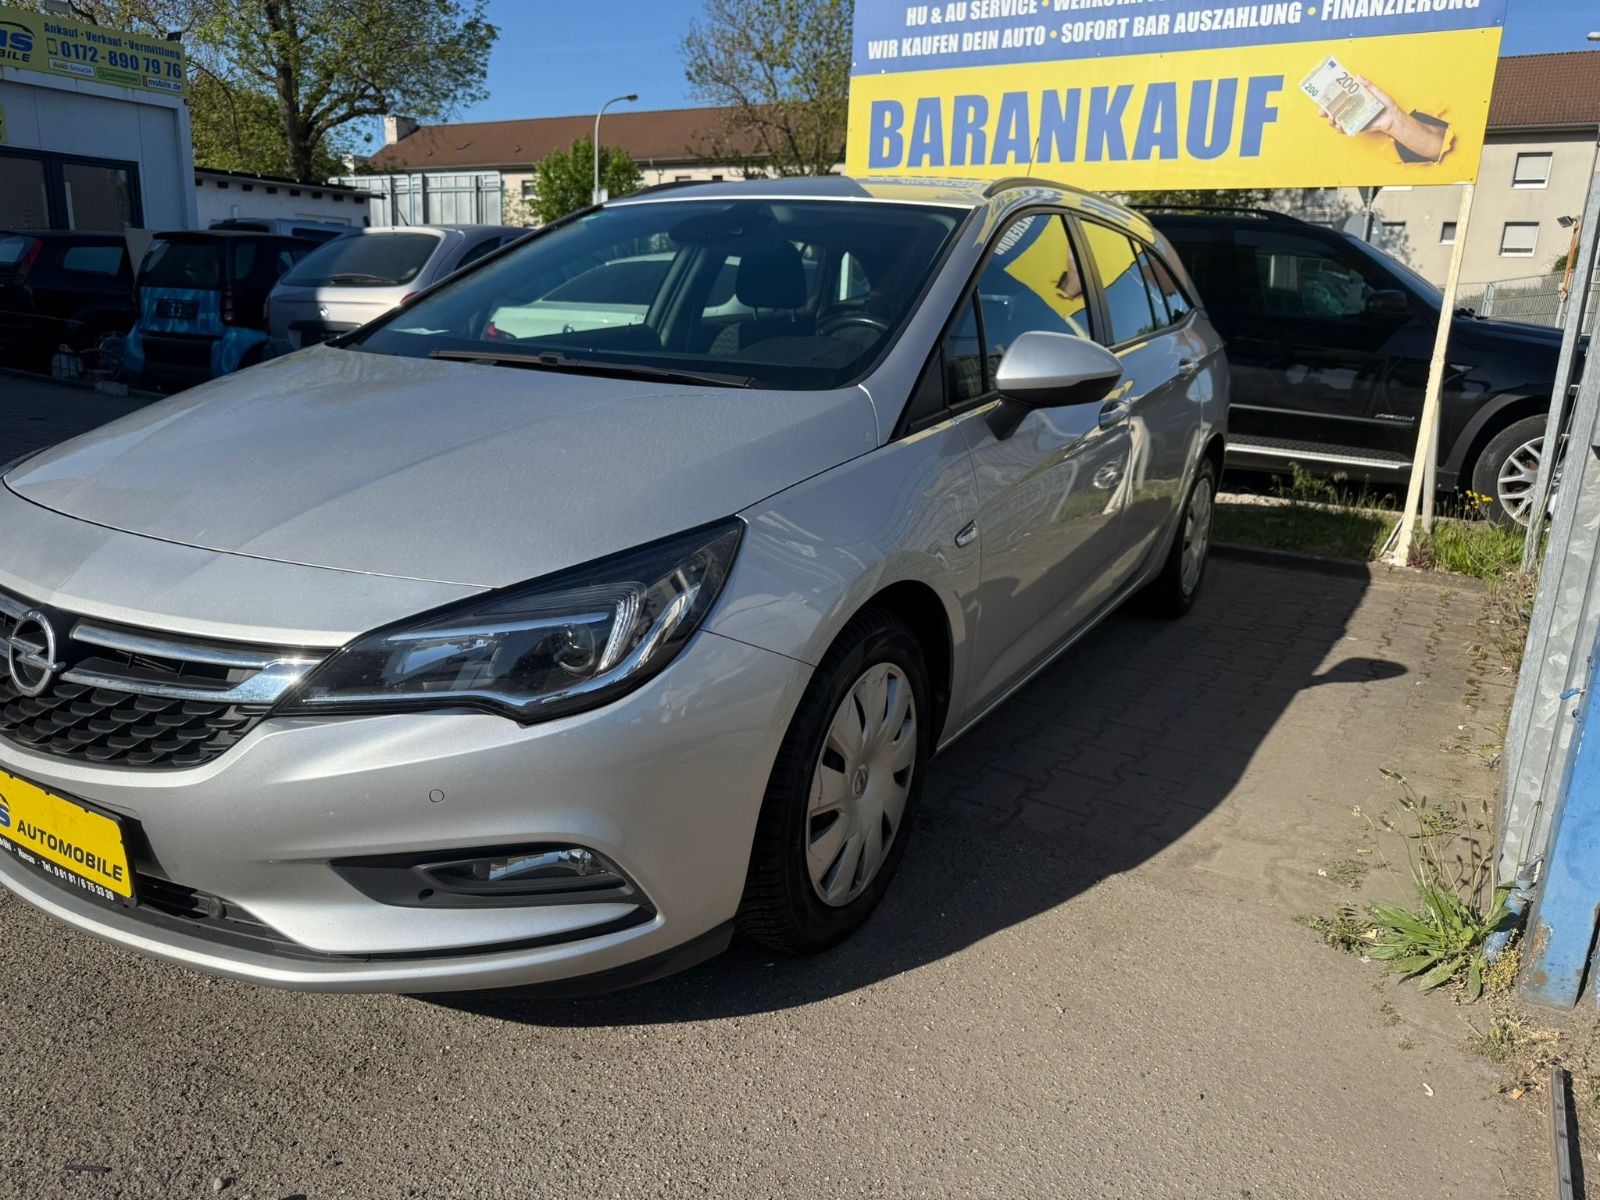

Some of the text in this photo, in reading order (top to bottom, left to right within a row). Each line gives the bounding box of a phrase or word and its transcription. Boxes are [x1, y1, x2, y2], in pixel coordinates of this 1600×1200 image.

[905, 6, 928, 26] HU
[930, 7, 942, 24] &
[944, 2, 968, 23] AU
[970, 0, 1038, 20] SERVICE
[44, 22, 181, 60] Ankauf Verkauf Vermittlung
[868, 38, 899, 60] WIR
[901, 33, 960, 57] KAUFEN
[962, 29, 1000, 54] DEIN
[1001, 25, 1046, 49] AUTO
[1061, 18, 1130, 44] SOFORT
[1132, 14, 1171, 38] BAR
[1173, 1, 1302, 35] AUSZAHLUNG
[143, 57, 161, 75] 79
[165, 61, 182, 79] 76
[1335, 71, 1360, 95] 200
[1304, 82, 1320, 97] 200
[868, 75, 1284, 169] BARANKAUF
[17, 820, 123, 882] AUTOMOBILE
